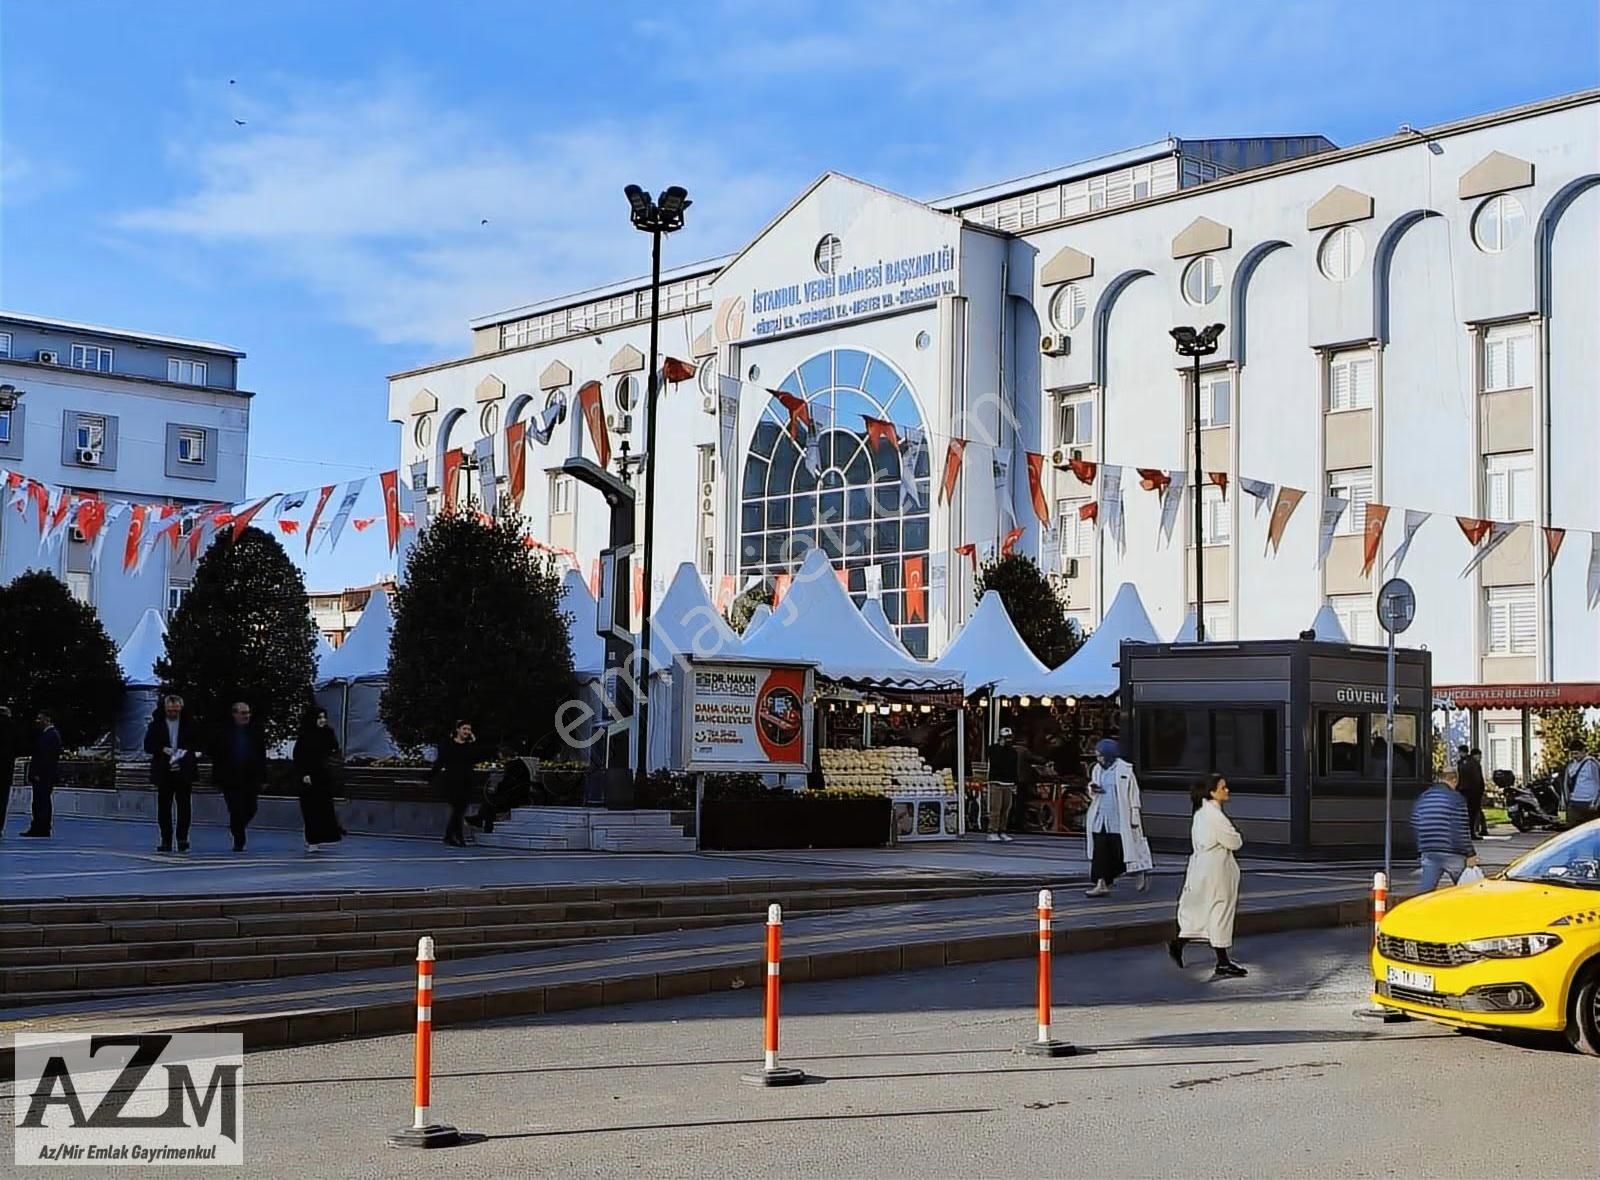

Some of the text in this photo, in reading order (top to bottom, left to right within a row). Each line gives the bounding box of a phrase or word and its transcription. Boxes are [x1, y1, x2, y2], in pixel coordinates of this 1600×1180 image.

[752, 245, 954, 314] İSTANBUL VERGİ DAİRESİ BAŞKANLIĞI
[1336, 687, 1400, 706] GÜVENLK
